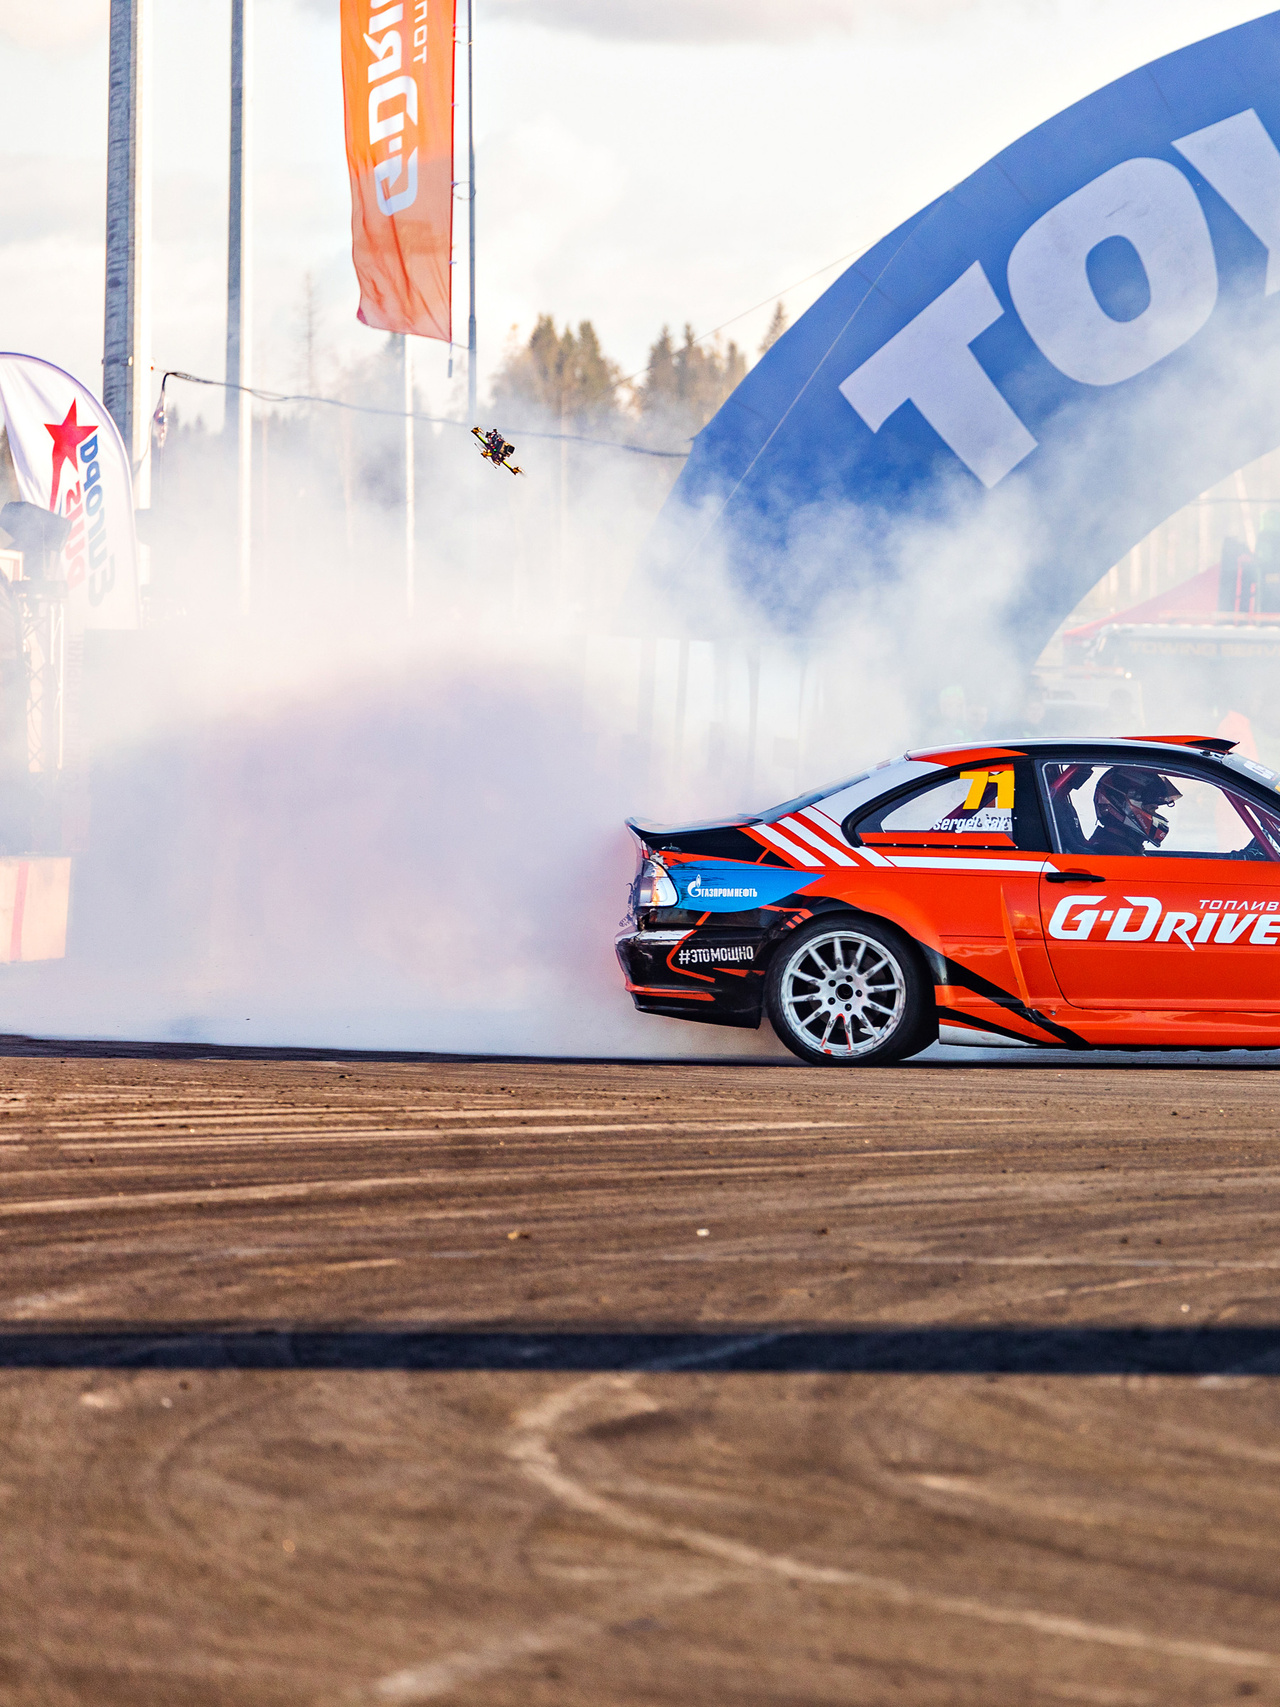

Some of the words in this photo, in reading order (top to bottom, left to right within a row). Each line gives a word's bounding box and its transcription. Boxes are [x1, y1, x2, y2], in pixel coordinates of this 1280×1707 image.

[1129, 640, 1217, 656] TOWING
[960, 770, 1015, 810] 71
[678, 946, 755, 965] #ЭТОМОЩНО
